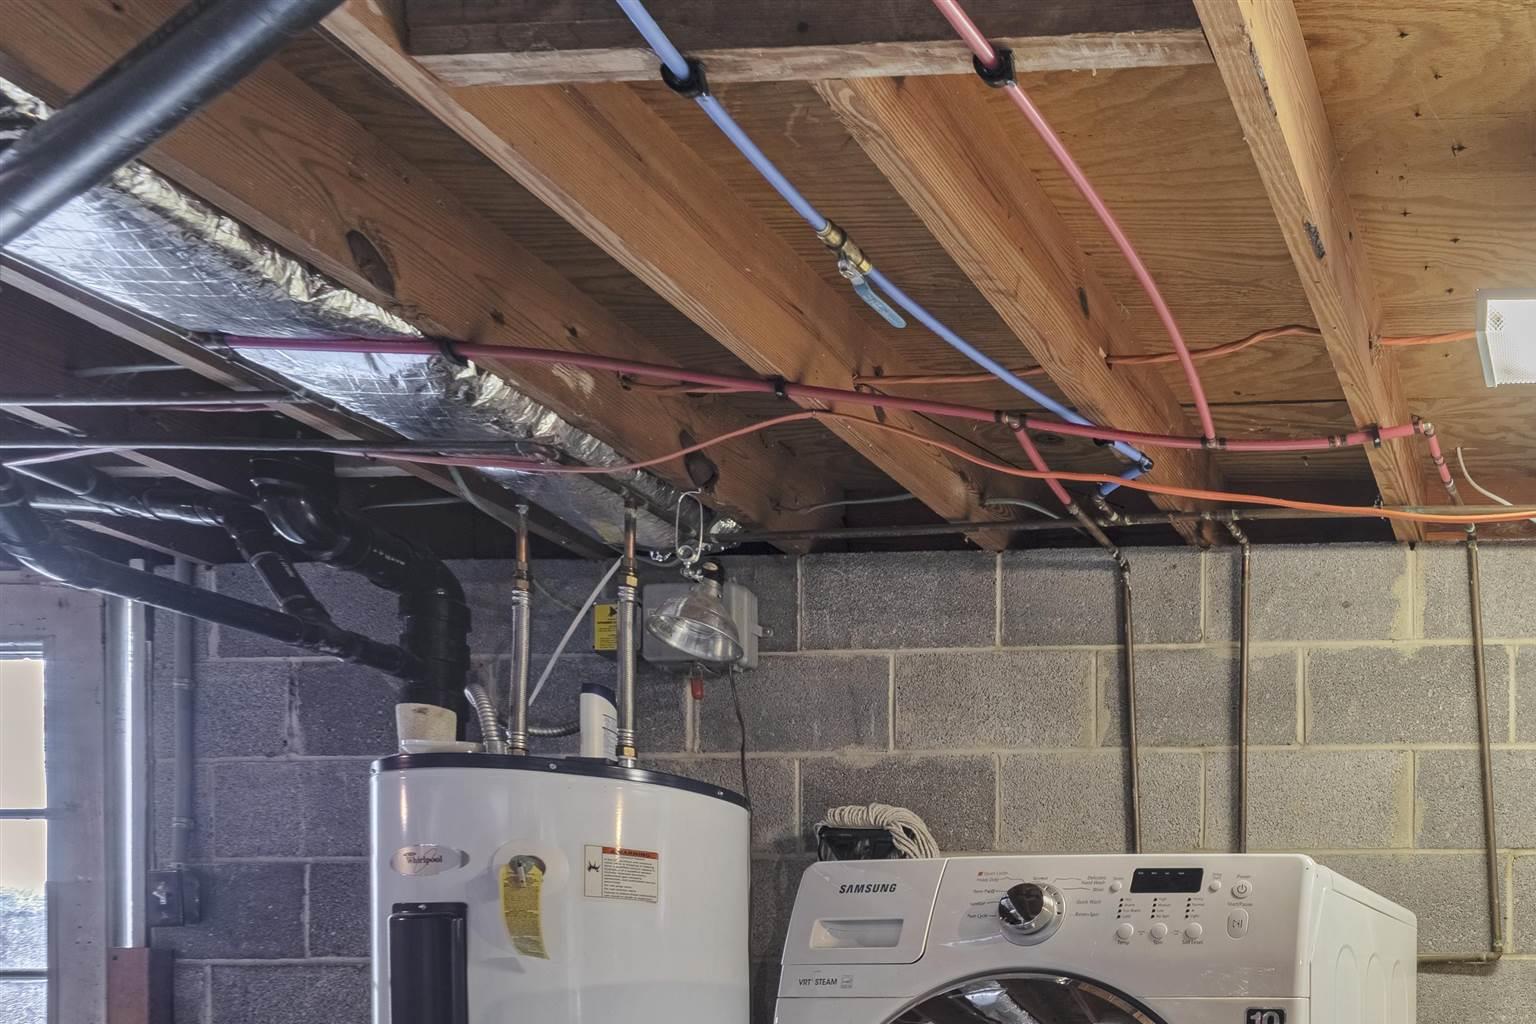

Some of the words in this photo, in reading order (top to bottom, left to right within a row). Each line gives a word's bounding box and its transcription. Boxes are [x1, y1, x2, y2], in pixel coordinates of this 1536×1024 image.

[406, 854, 443, 865] Whirlpool
[838, 883, 897, 895] SAMSUNG
[814, 978, 838, 986] STEAM
